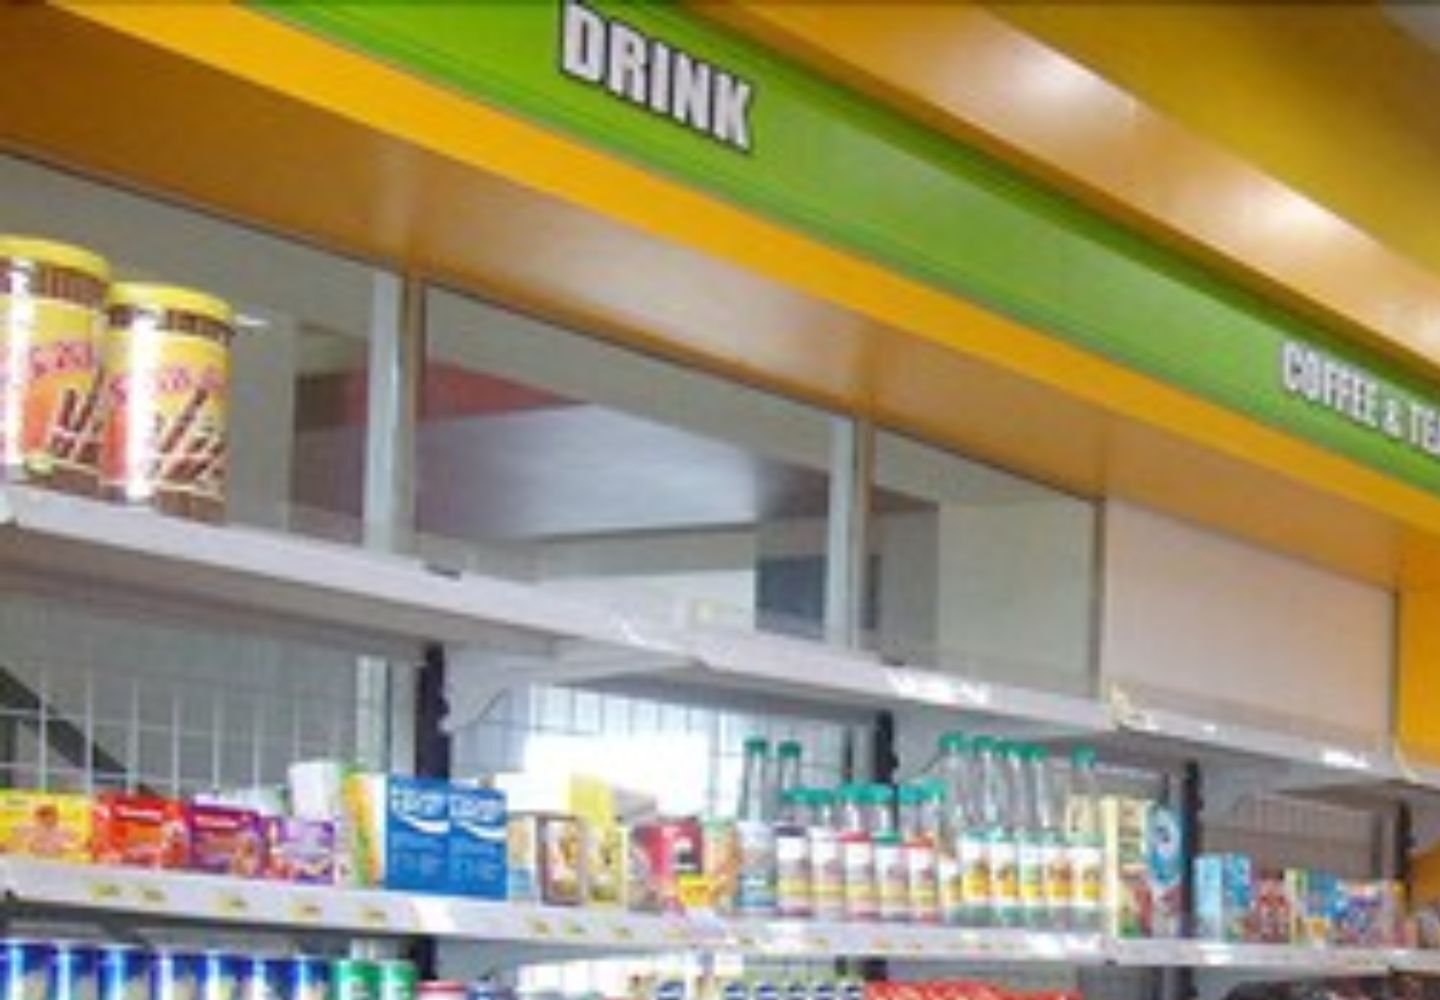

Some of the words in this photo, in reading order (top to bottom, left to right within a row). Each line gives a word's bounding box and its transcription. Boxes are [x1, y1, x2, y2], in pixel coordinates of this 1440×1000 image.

[560, 2, 752, 153] DRINK
[1281, 341, 1380, 430] COFFEE
[1381, 398, 1402, 440] &
